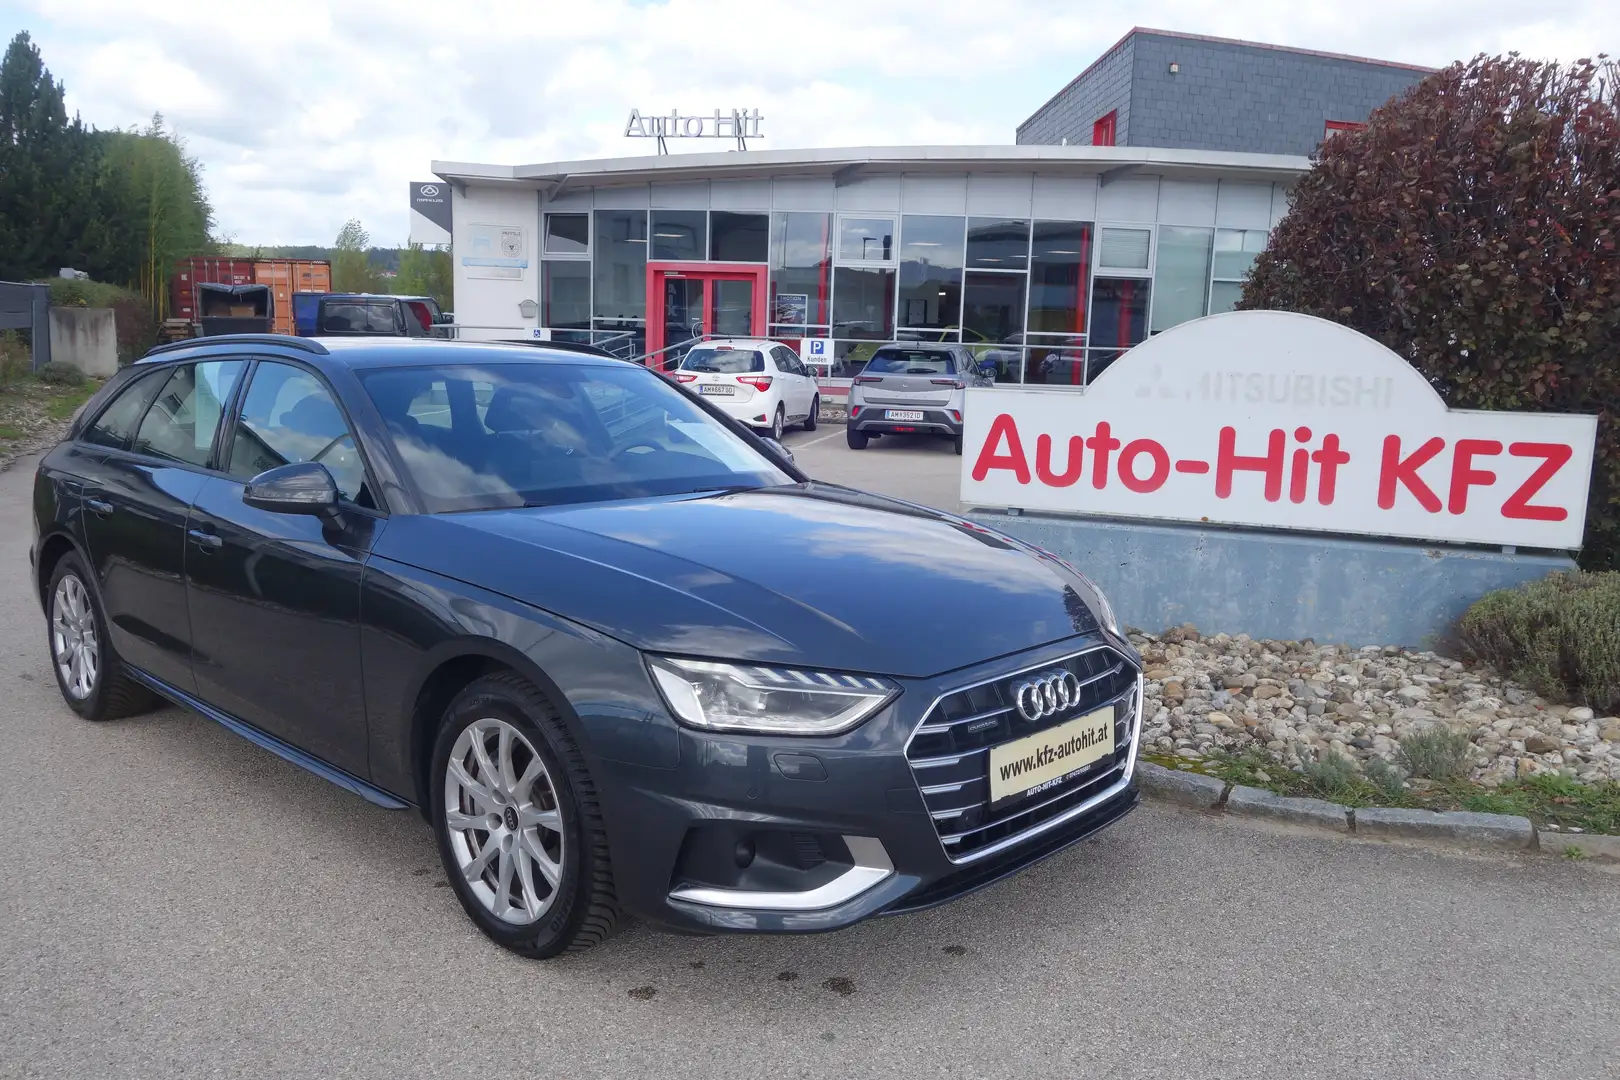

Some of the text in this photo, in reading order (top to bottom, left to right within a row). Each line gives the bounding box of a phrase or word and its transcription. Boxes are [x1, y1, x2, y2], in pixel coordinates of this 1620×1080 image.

[623, 108, 764, 138] Auto Hit
[971, 413, 1574, 522] Auto-Hit KFZ
[1000, 722, 1108, 781] www.kfz-autohit.at
[1026, 776, 1063, 797] AUTO-HIT-KFZ
